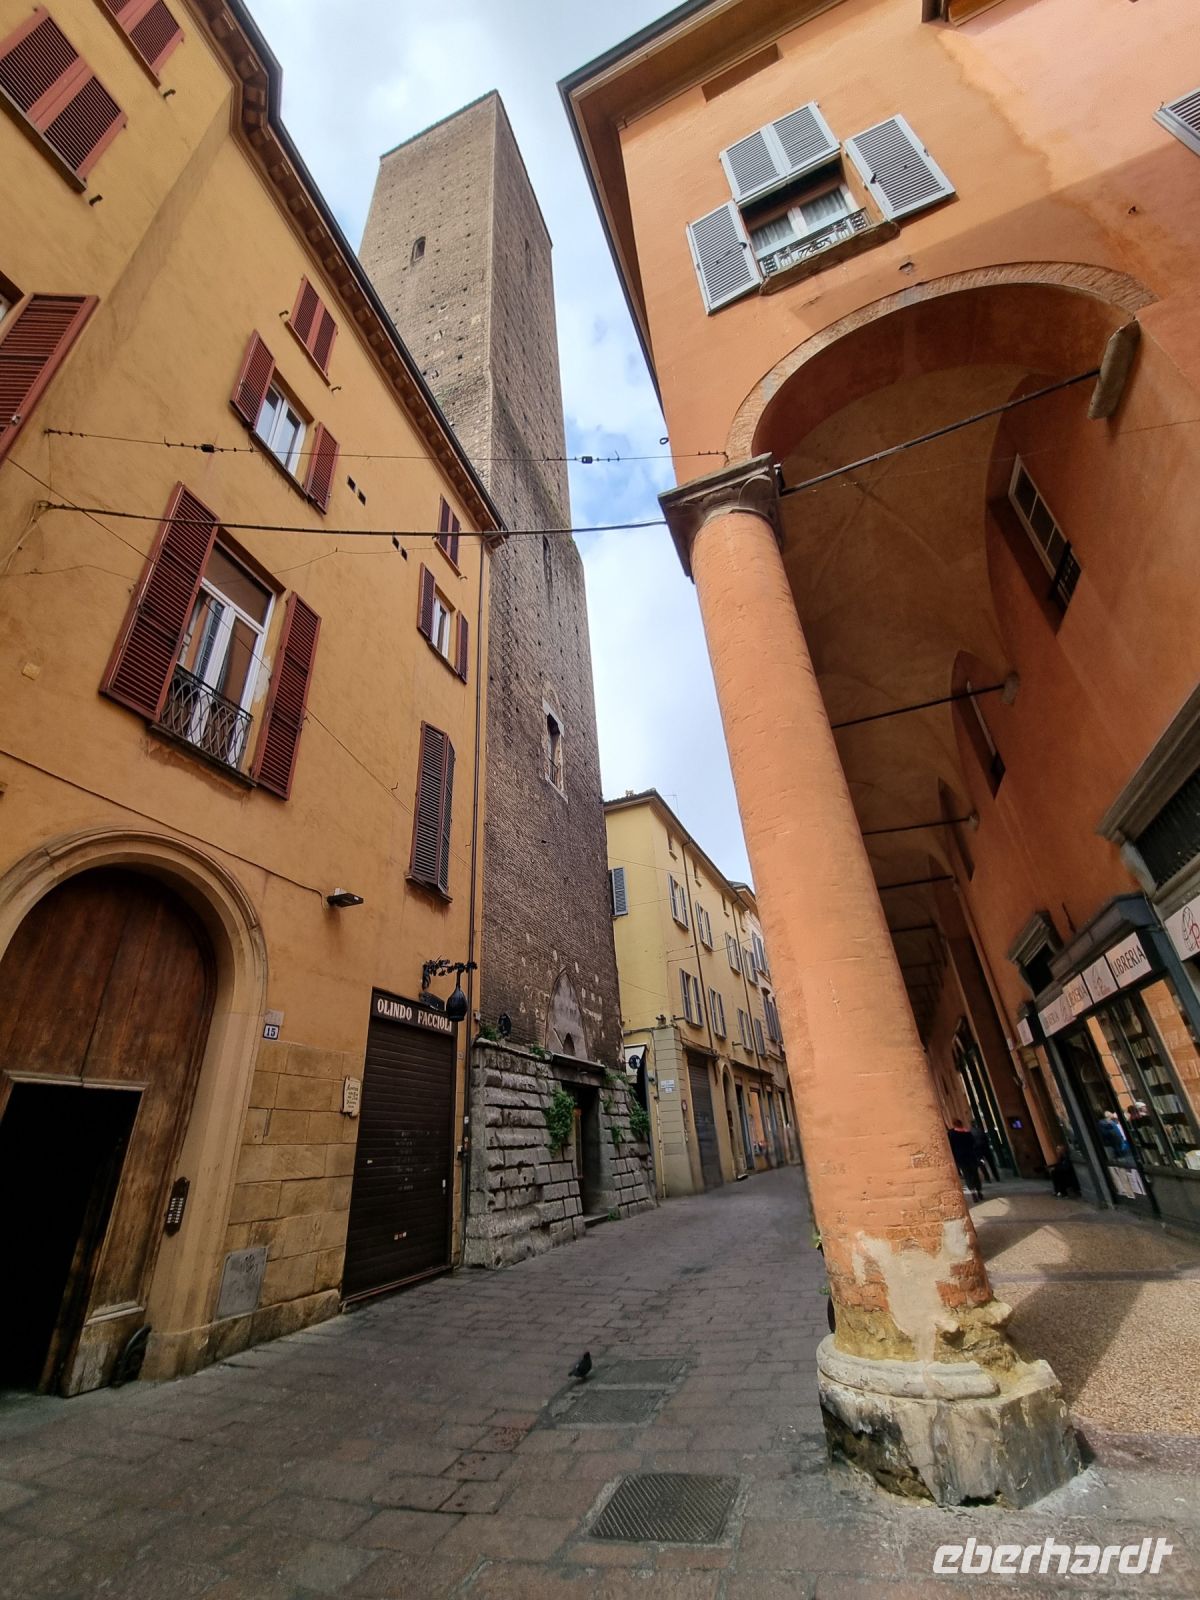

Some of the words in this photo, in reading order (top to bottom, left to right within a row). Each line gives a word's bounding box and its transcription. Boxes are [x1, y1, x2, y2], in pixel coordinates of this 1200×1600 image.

[1110, 945, 1146, 978] LIBRERIA
[377, 998, 412, 1020] OLINDO
[417, 1010, 452, 1032] FACCIOLI
[266, 1027, 276, 1037] 15
